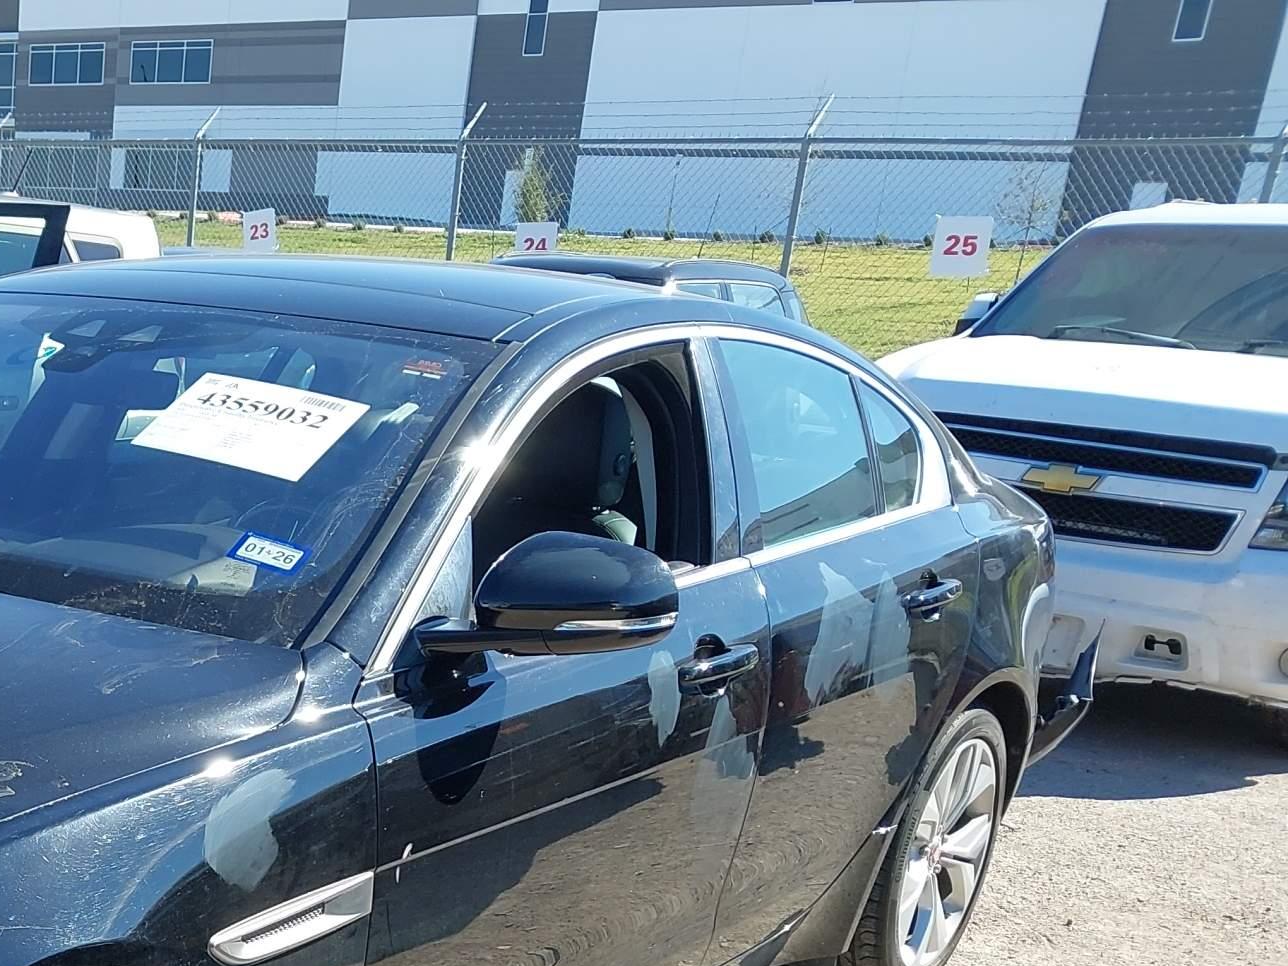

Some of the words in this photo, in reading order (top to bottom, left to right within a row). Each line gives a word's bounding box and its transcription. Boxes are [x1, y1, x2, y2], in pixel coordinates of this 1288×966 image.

[250, 222, 269, 240] 23
[524, 237, 547, 251] 24
[943, 234, 978, 256] 25
[197, 392, 329, 429] 43559032
